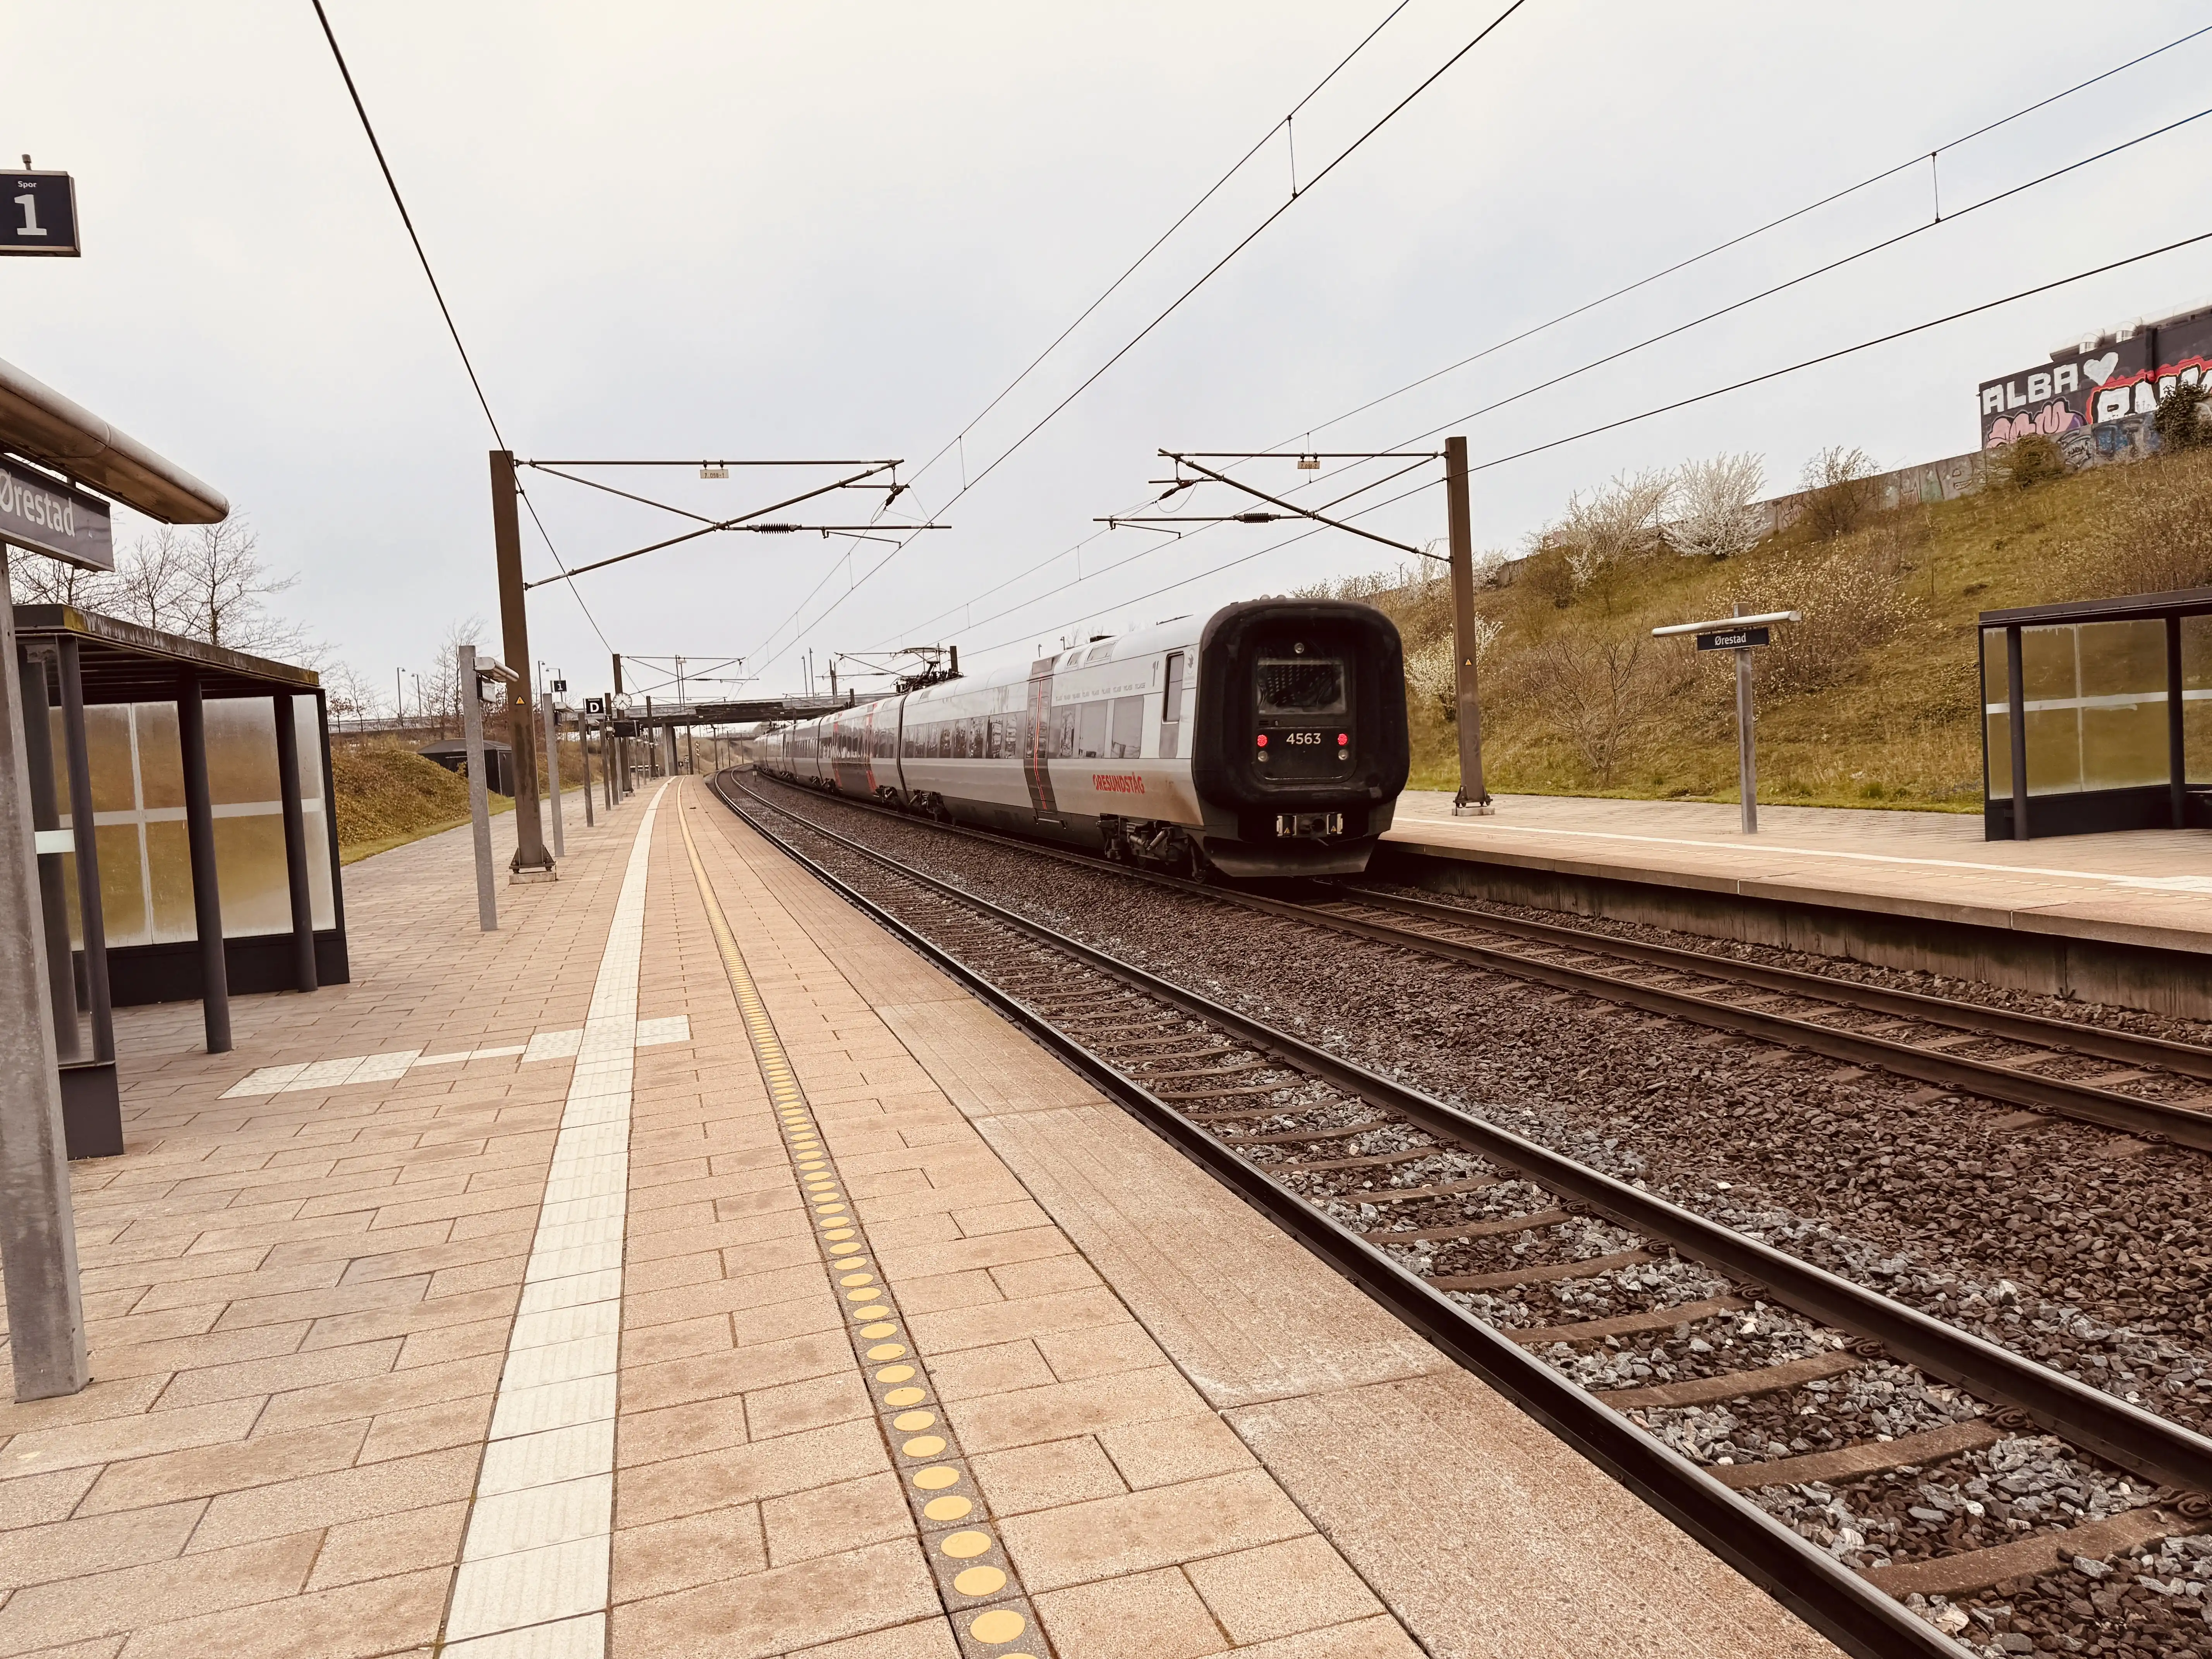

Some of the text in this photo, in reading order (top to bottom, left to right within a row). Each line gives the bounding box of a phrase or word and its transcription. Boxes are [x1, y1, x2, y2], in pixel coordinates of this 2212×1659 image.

[14, 194, 47, 235] 1
[1982, 363, 2078, 415] ALBA
[0, 468, 75, 538] Ørestad
[1715, 632, 1746, 646] Ørestad
[590, 702, 599, 713] D
[1286, 733, 1321, 744] 4563
